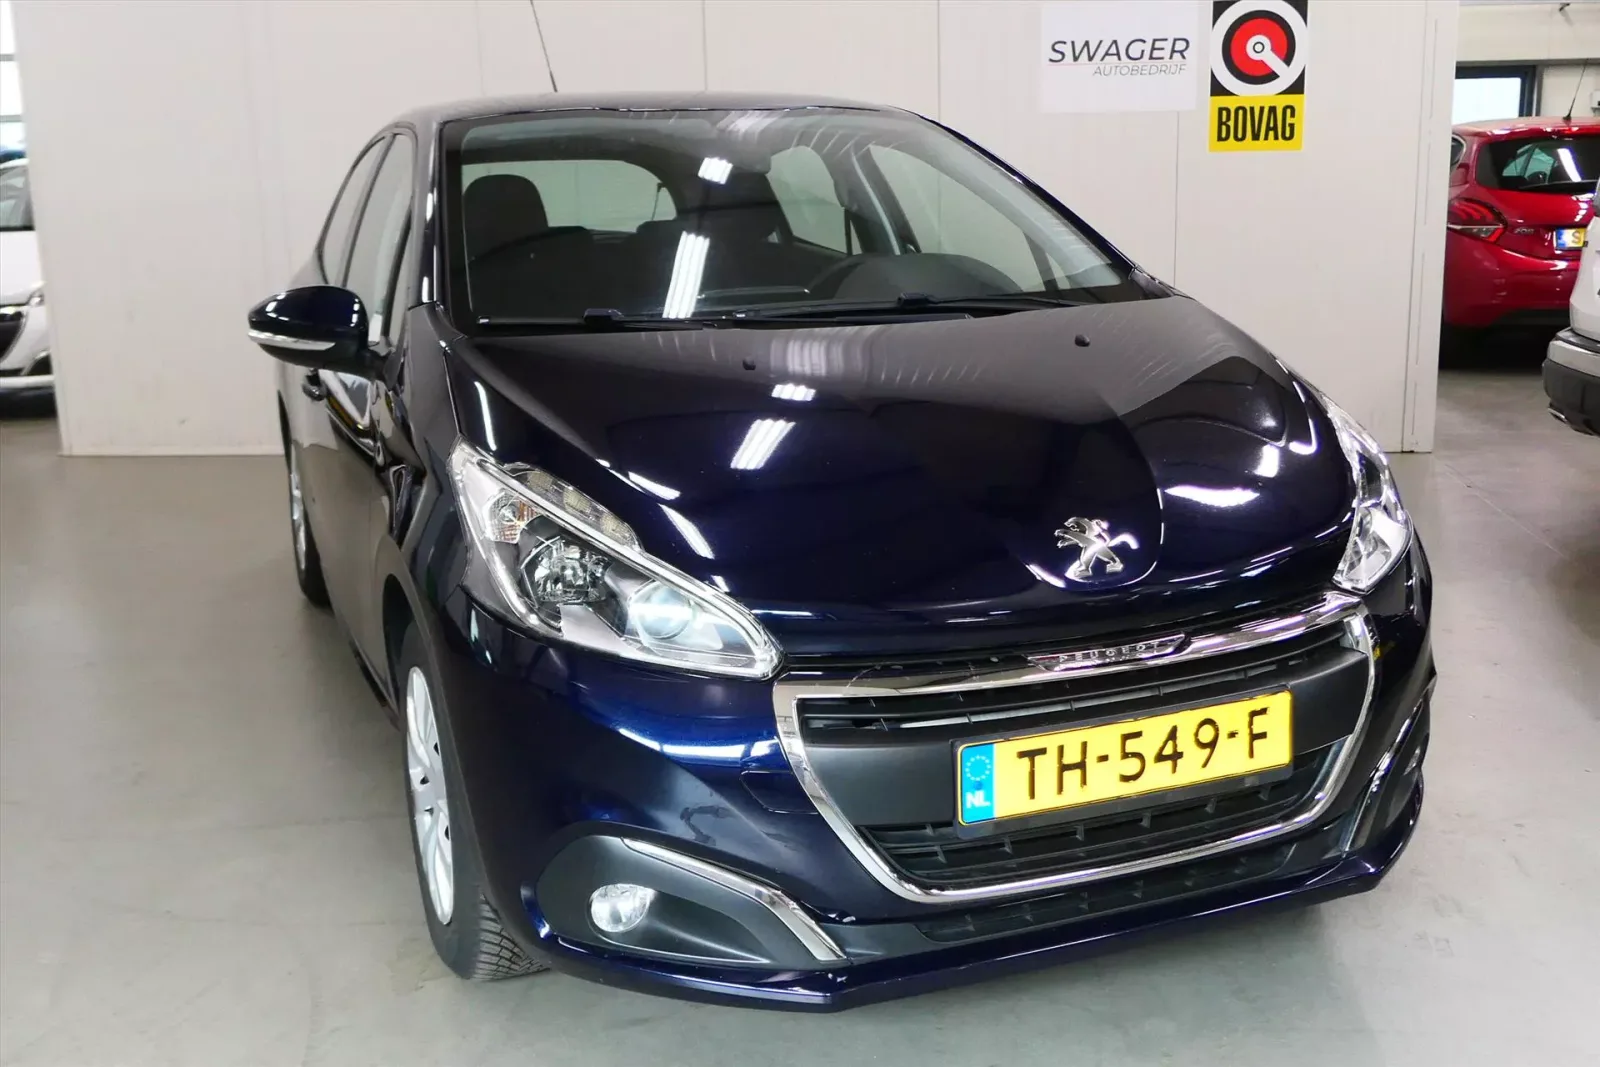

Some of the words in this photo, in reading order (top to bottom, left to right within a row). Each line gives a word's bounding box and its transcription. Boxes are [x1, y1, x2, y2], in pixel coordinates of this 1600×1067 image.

[1049, 38, 1190, 63] SWAGER
[1092, 64, 1187, 77] AUTOBEDRIJF
[1216, 105, 1296, 142] BOVAG
[1016, 706, 1270, 800] TH-549-F
[965, 791, 991, 809] NL
